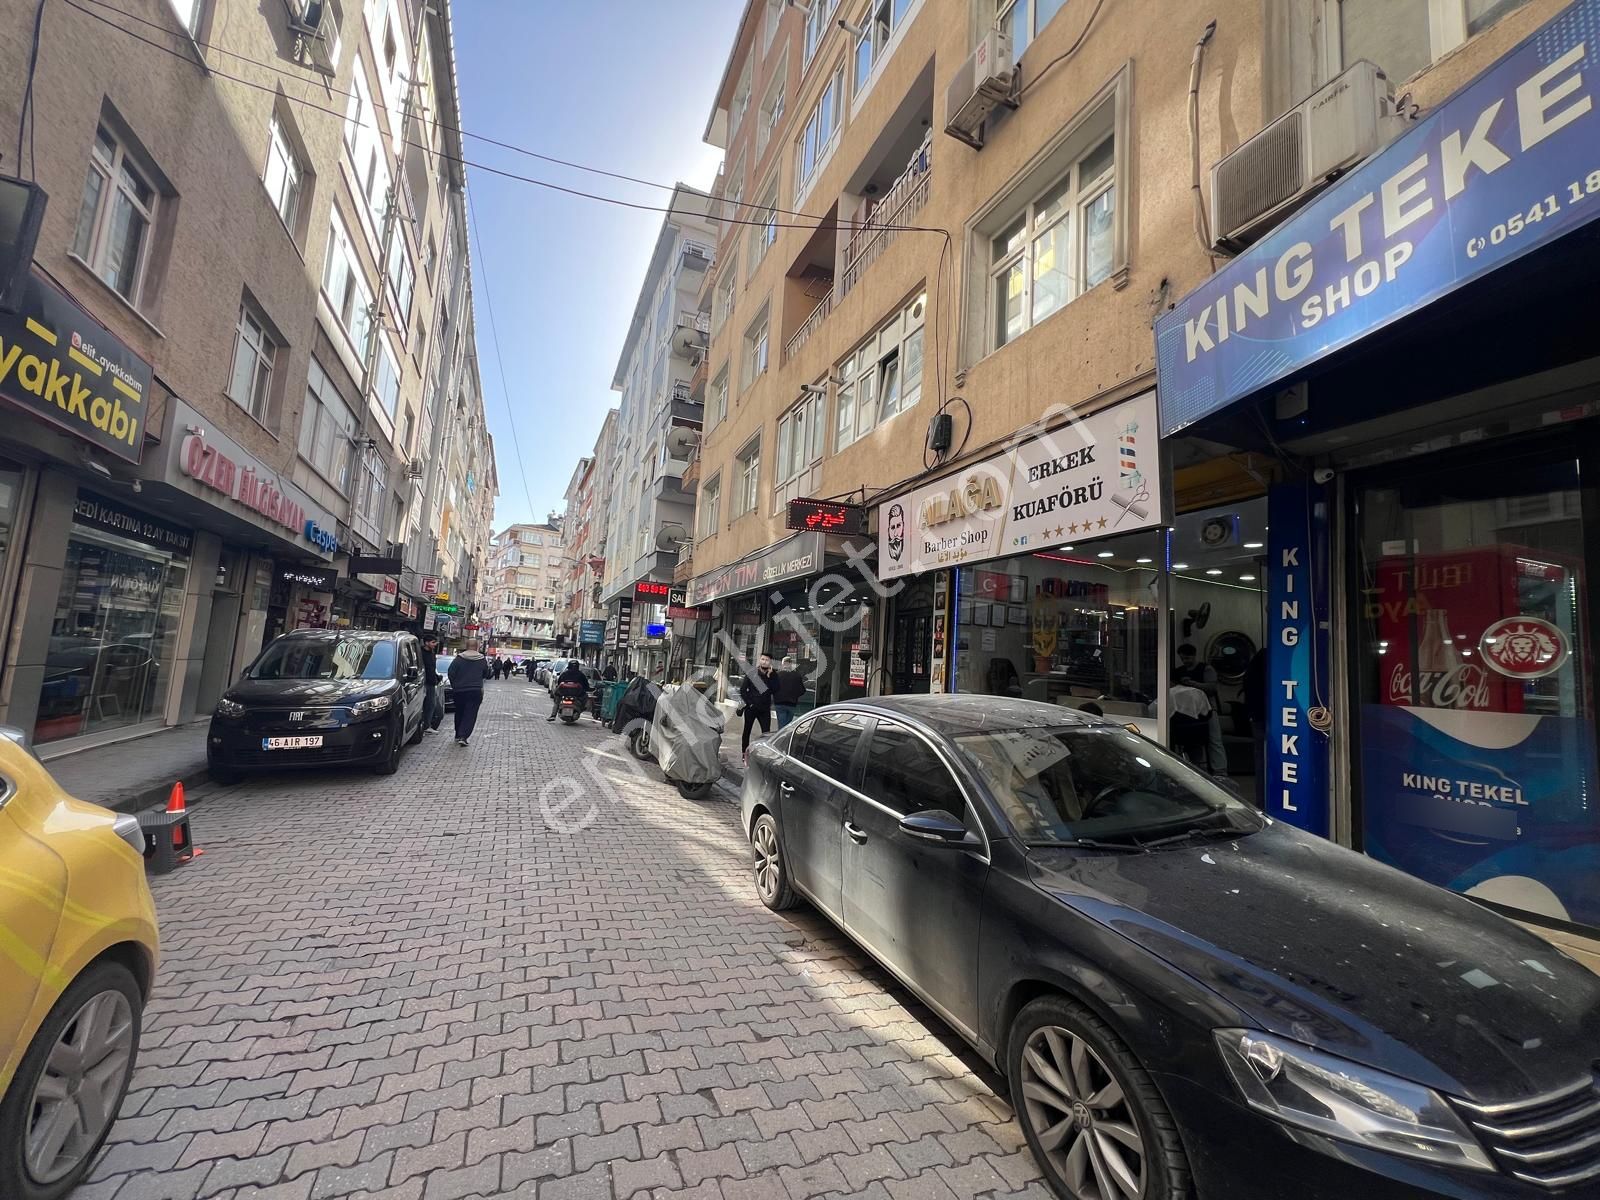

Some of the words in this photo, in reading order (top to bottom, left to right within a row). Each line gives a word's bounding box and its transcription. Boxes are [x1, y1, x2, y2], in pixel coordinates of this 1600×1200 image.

[1489, 194, 1561, 247] 0541
[1567, 169, 1600, 205] 18
[1184, 241, 1315, 363] KING
[1301, 241, 1415, 329] SHOP
[180, 424, 237, 498] ÖZER
[232, 465, 306, 536] BİLGİSAYAR
[1027, 445, 1096, 484] ERKEK
[99, 506, 141, 533] KARTINA
[917, 474, 1003, 530] ALAĞA
[1013, 476, 1104, 522] KUAFÖRÜ
[924, 535, 958, 554] Barber
[960, 529, 988, 547] Shop
[425, 580, 437, 593] E
[1281, 547, 1299, 646] KING
[288, 711, 305, 722] FIAT
[269, 738, 280, 748] 46
[283, 737, 301, 747] AIR
[304, 736, 321, 747] 197
[1281, 680, 1299, 812] TEKEL
[1403, 772, 1451, 793] KING
[1456, 780, 1529, 806] TEKEL
